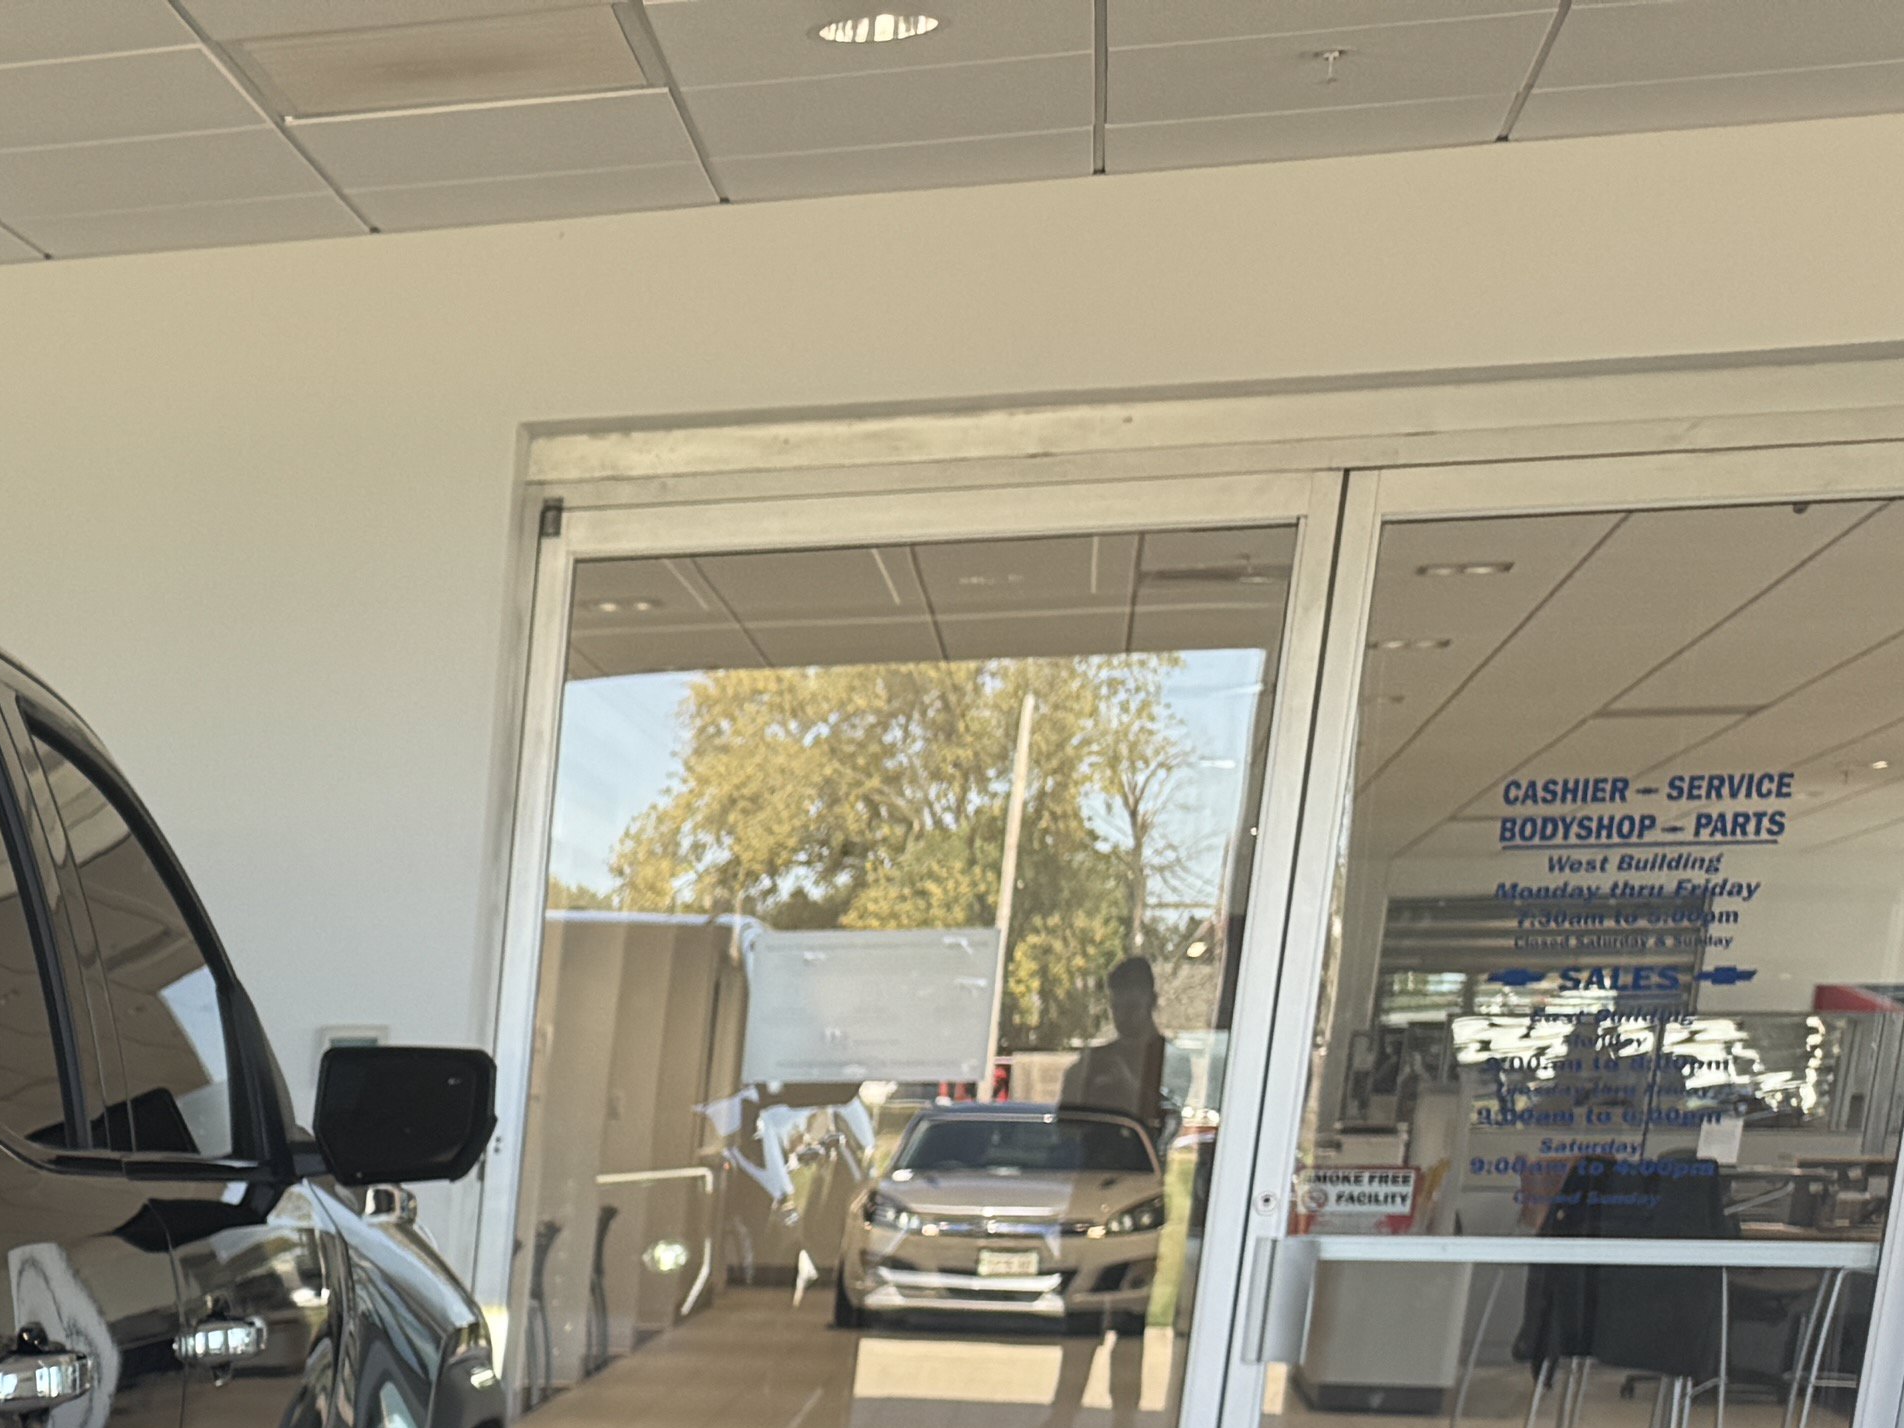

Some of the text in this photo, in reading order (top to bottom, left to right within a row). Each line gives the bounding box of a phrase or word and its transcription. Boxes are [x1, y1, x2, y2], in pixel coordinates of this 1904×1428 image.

[1503, 777, 1630, 806] CASHIER
[1666, 772, 1794, 802] SERVICE
[1499, 814, 1656, 842] BODYSHOP
[1693, 811, 1786, 838] PARTS
[1548, 852, 1725, 874] West Building
[1495, 878, 1761, 905] Monday thru Friday
[1614, 909, 1638, 927] to
[1558, 965, 1682, 992] SALES
[1594, 1055, 1619, 1073] to
[1585, 1106, 1612, 1125] to
[1540, 1138, 1642, 1158] Saturday
[1577, 1157, 1606, 1176] to
[1367, 1172, 1412, 1187] FREE
[1334, 1190, 1409, 1207] FACILITY
